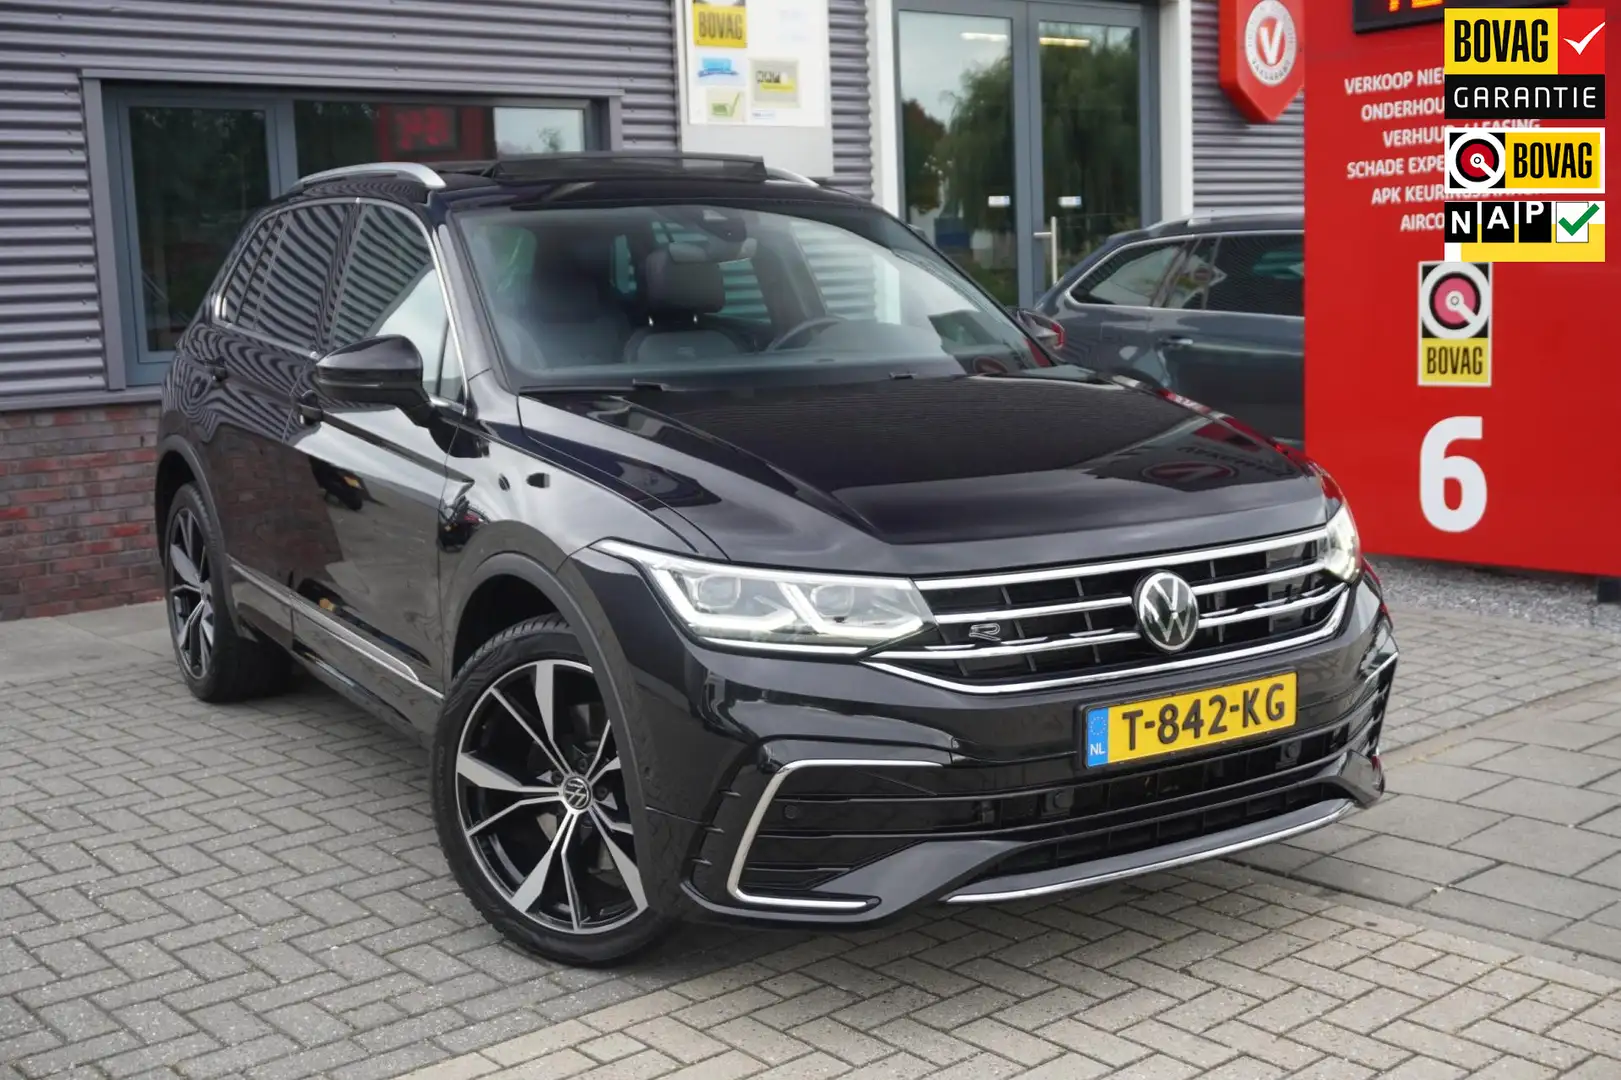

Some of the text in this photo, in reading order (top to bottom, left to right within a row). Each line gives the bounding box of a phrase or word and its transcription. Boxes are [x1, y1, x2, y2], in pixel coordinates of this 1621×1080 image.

[698, 11, 743, 40] BOVAG
[1344, 67, 1445, 95] VERKOOP NIE
[1361, 96, 1445, 122] ONDERHOU
[1383, 125, 1455, 148] VERHUU
[1346, 154, 1445, 180] SCHADE EXPE
[1371, 186, 1402, 206] APK
[1400, 211, 1445, 233] AIRCO
[1427, 346, 1483, 375] BOVAG
[1419, 416, 1488, 533] 6
[1090, 683, 1285, 756] NL T-842-KG
